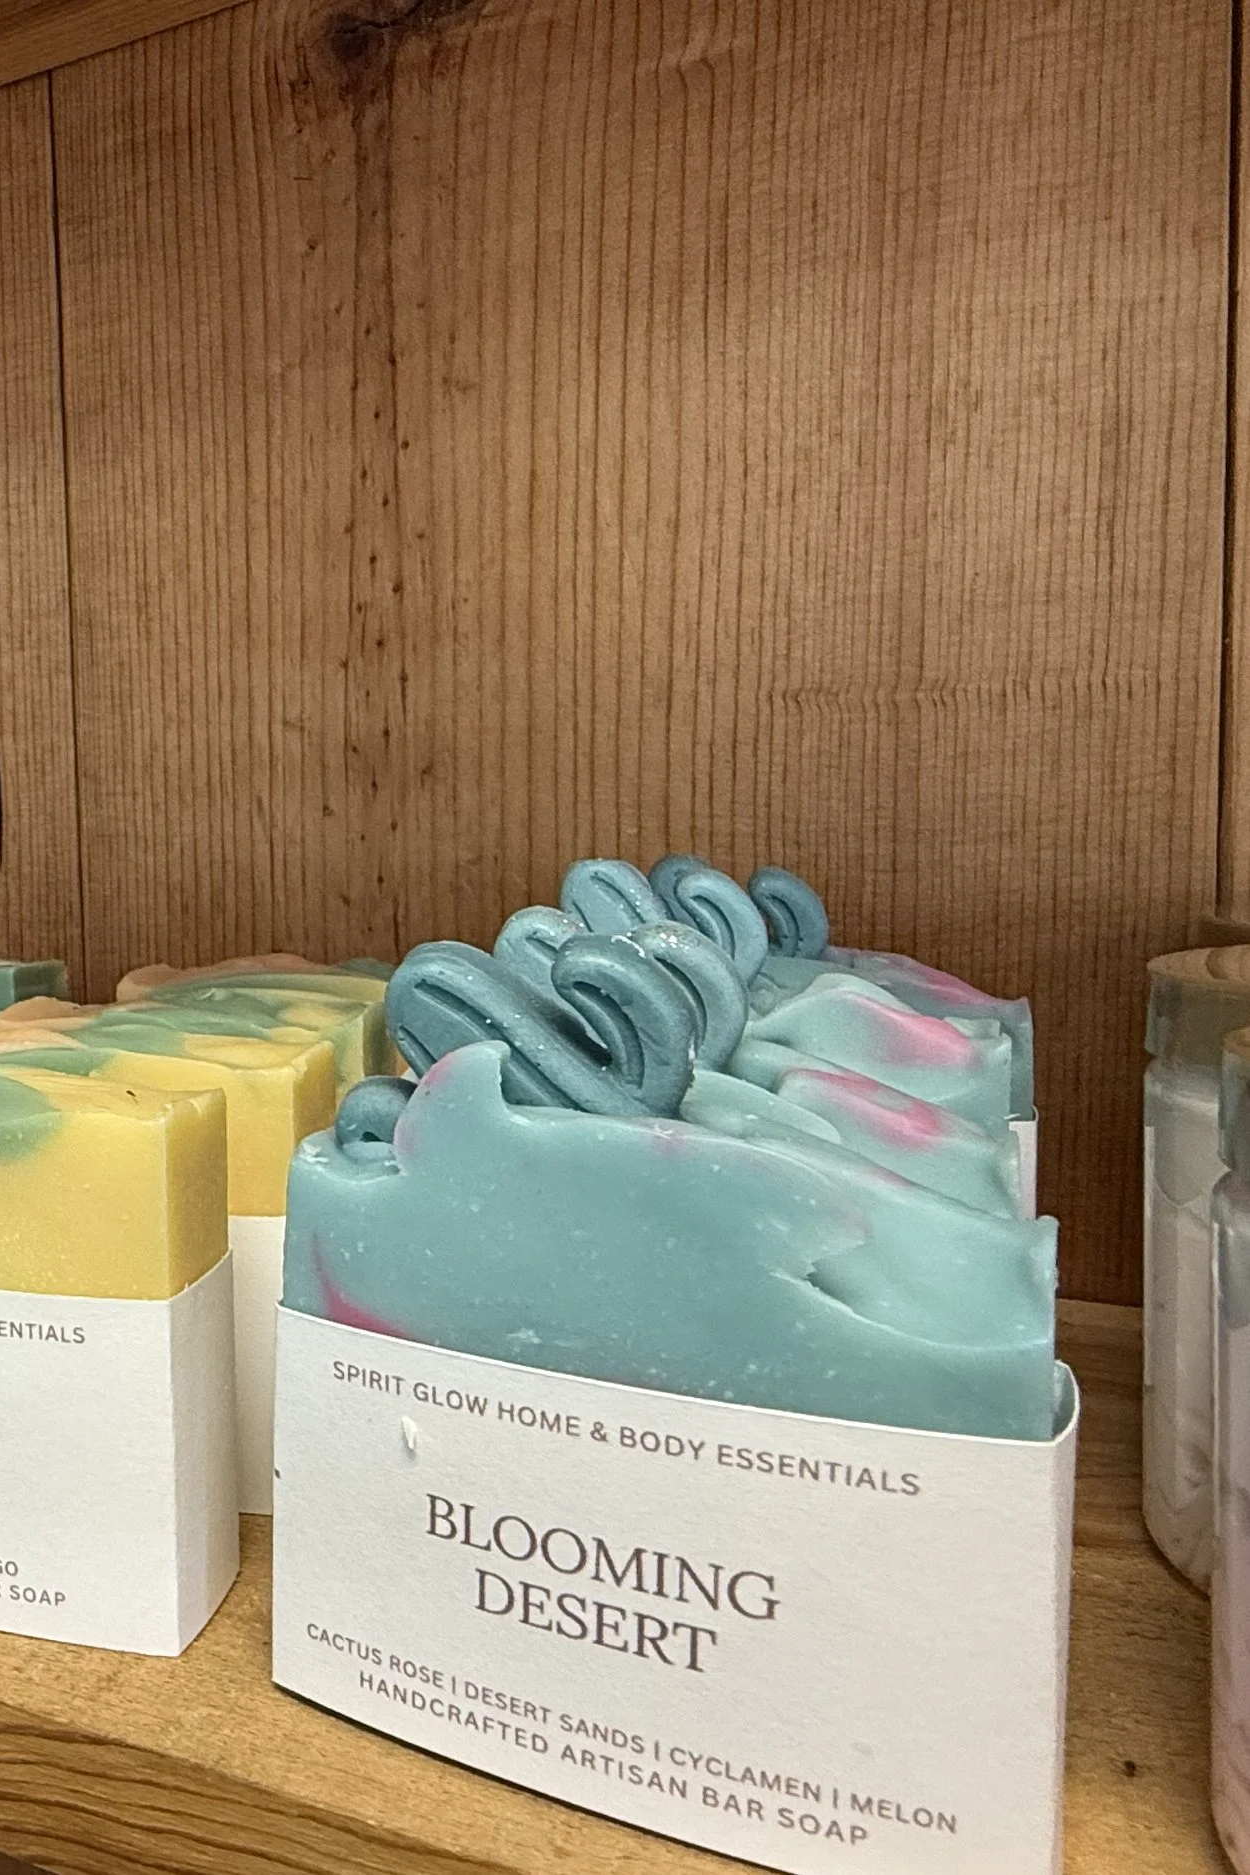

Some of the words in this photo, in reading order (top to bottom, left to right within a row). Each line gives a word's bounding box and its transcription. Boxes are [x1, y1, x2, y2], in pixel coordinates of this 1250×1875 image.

[333, 1360, 406, 1396] SPIRIT
[413, 1382, 488, 1417] GLOW
[498, 1401, 582, 1437] HOME
[590, 1421, 608, 1443] &
[619, 1426, 706, 1460] BODY
[717, 1444, 920, 1496] ESSENTIALS
[9, 1584, 66, 1608] SOAP
[425, 1493, 780, 1621] BLOOMING
[474, 1568, 719, 1673] DESERT
[307, 1623, 382, 1666] CACTUS
[390, 1654, 444, 1689] ROSE
[464, 1681, 552, 1725] DESERT
[560, 1713, 645, 1754] SANDS
[669, 1746, 821, 1803] CYCLAMEN
[851, 1792, 958, 1834] MELON
[359, 1670, 548, 1754] HANDCRAFTED
[560, 1744, 688, 1799] ARTISAN
[702, 1786, 765, 1822] BAR
[777, 1806, 869, 1846] SOAP
